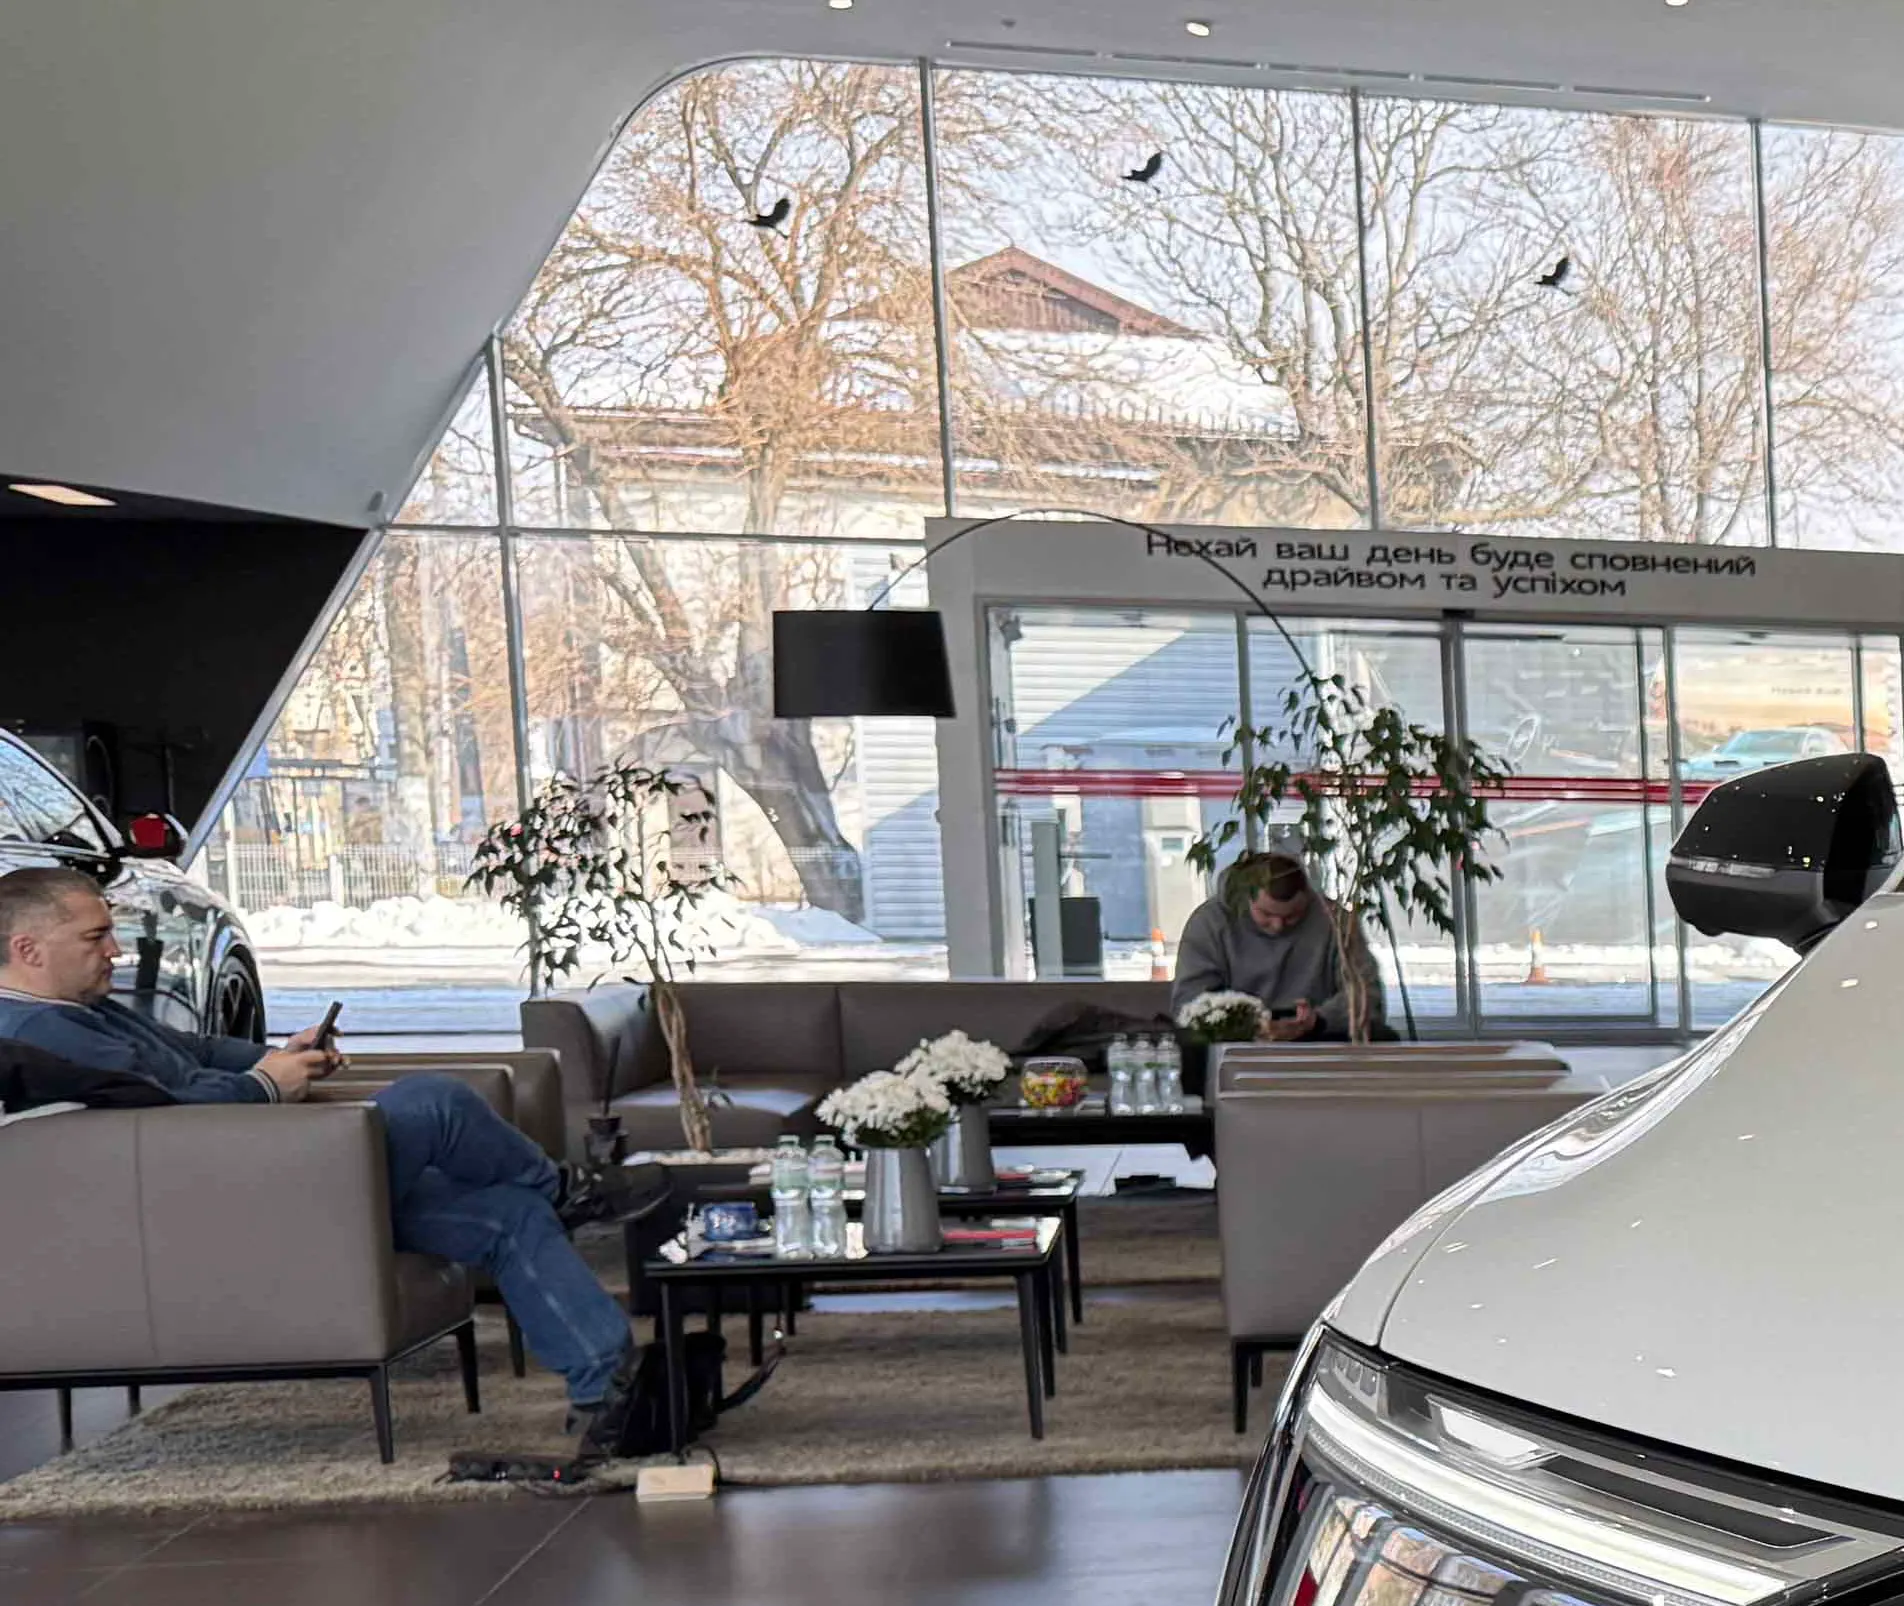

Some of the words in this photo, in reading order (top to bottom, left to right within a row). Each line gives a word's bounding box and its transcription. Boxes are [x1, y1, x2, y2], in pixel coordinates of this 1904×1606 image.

[1276, 541, 1348, 561] ваш
[1366, 545, 1457, 567] день
[1470, 542, 1555, 572] буде
[1570, 552, 1756, 577] сповнений
[1263, 566, 1426, 593] драйвом
[1440, 572, 1478, 591] та
[1493, 571, 1627, 599] успіхом
